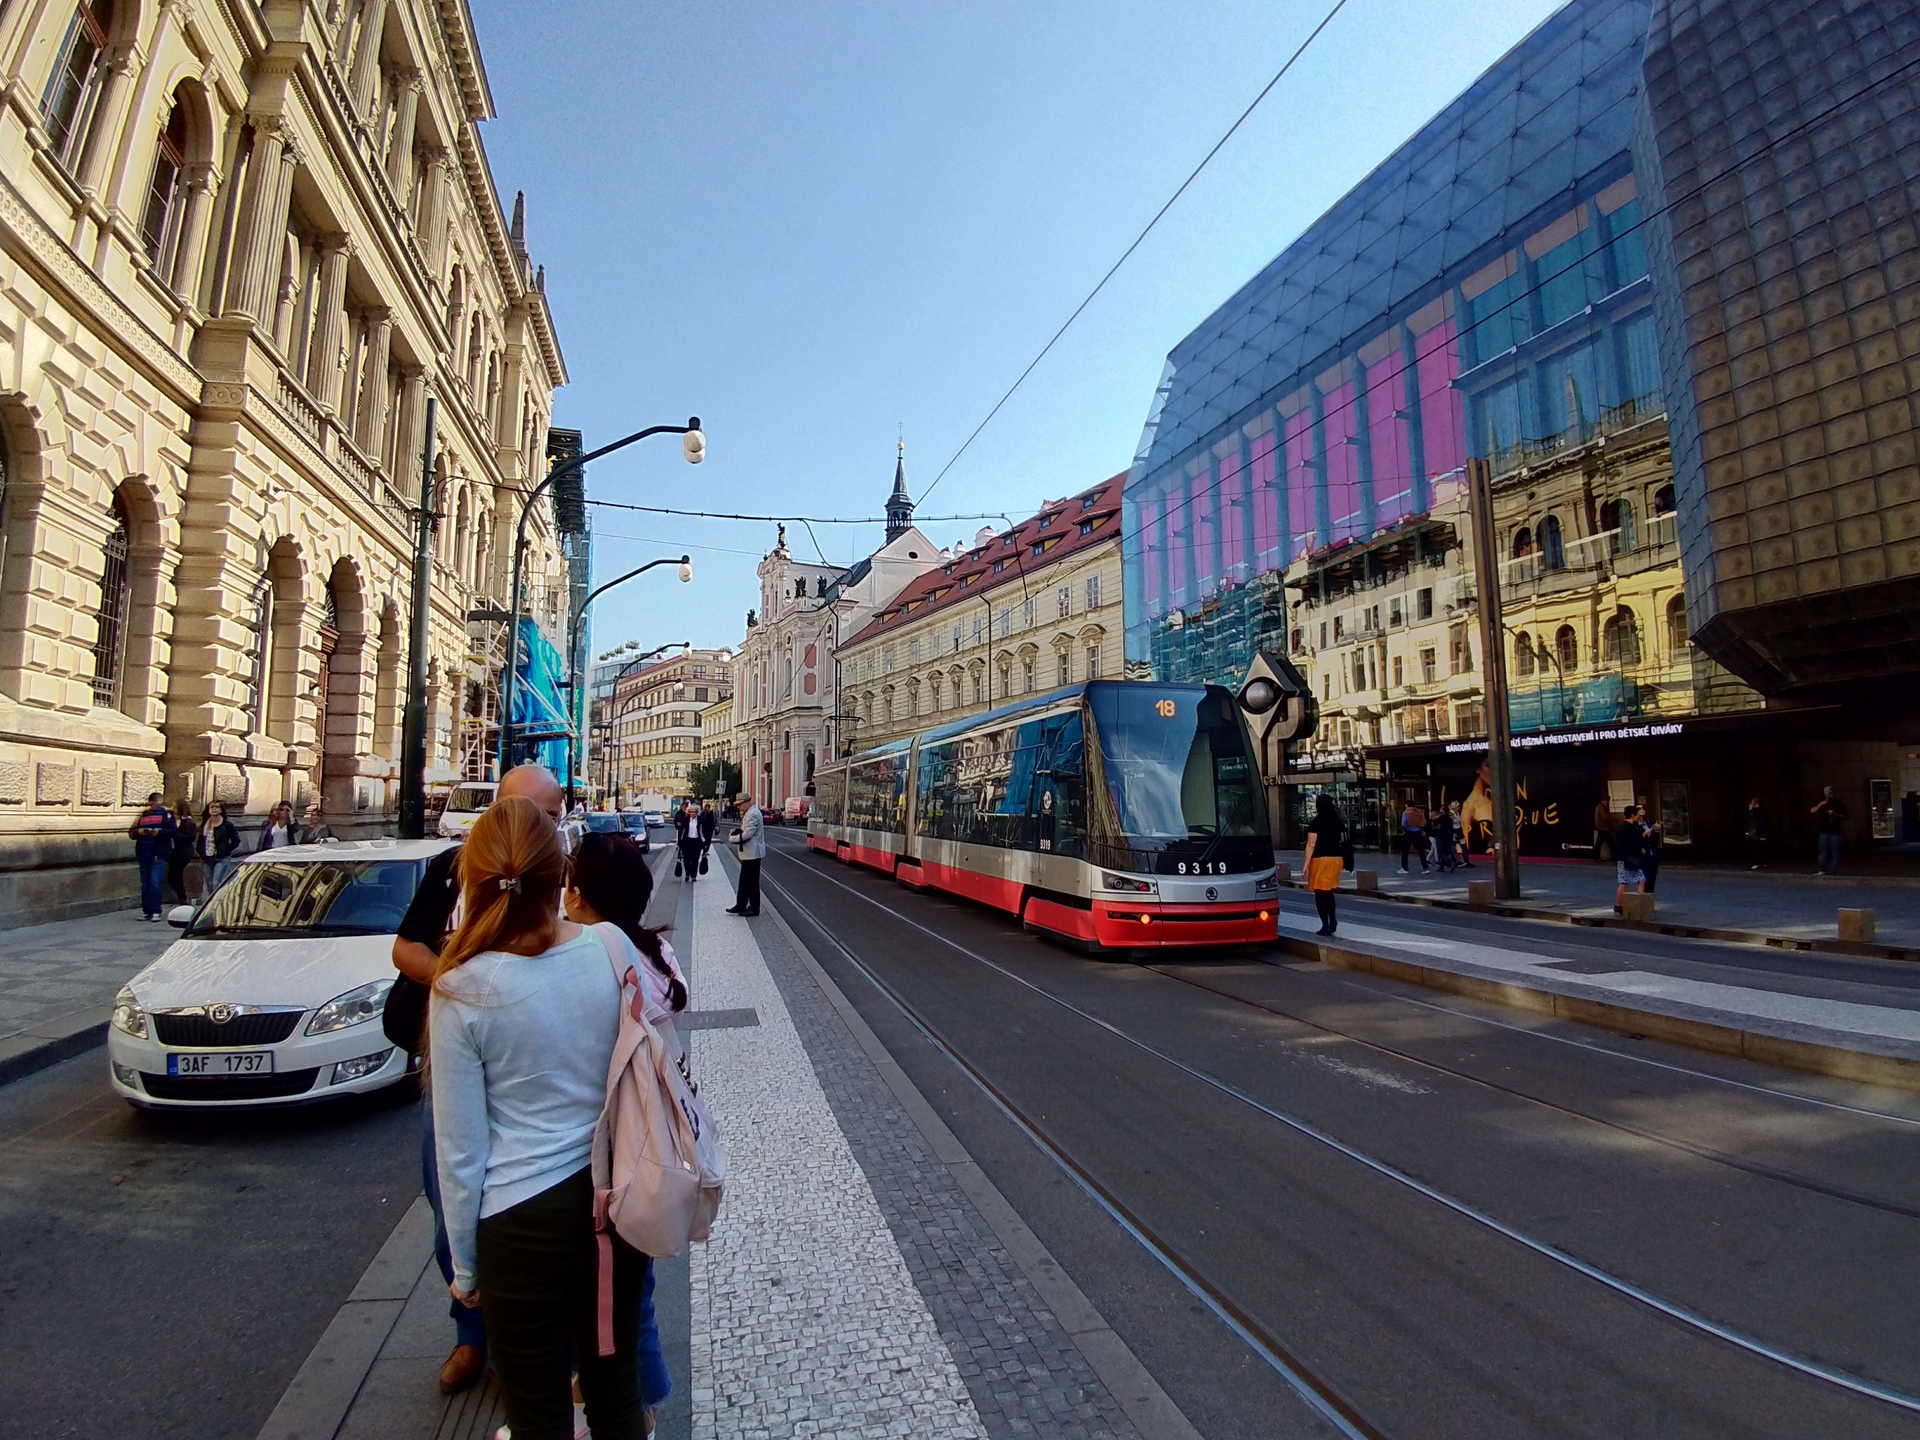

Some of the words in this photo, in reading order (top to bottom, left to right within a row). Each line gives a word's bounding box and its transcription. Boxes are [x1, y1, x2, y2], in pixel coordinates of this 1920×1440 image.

[1155, 699, 1176, 717] 18
[1544, 730, 1594, 744] PŘEDSTAVENÍ
[1599, 730, 1617, 740] PRO
[1617, 725, 1650, 738] DĚTSKÉ
[1651, 723, 1683, 736] DIVÁKY
[1040, 838, 1051, 850] 9319
[1177, 861, 1227, 875] 9319
[181, 1056, 210, 1073] 3AF
[224, 1054, 264, 1072] 1737
